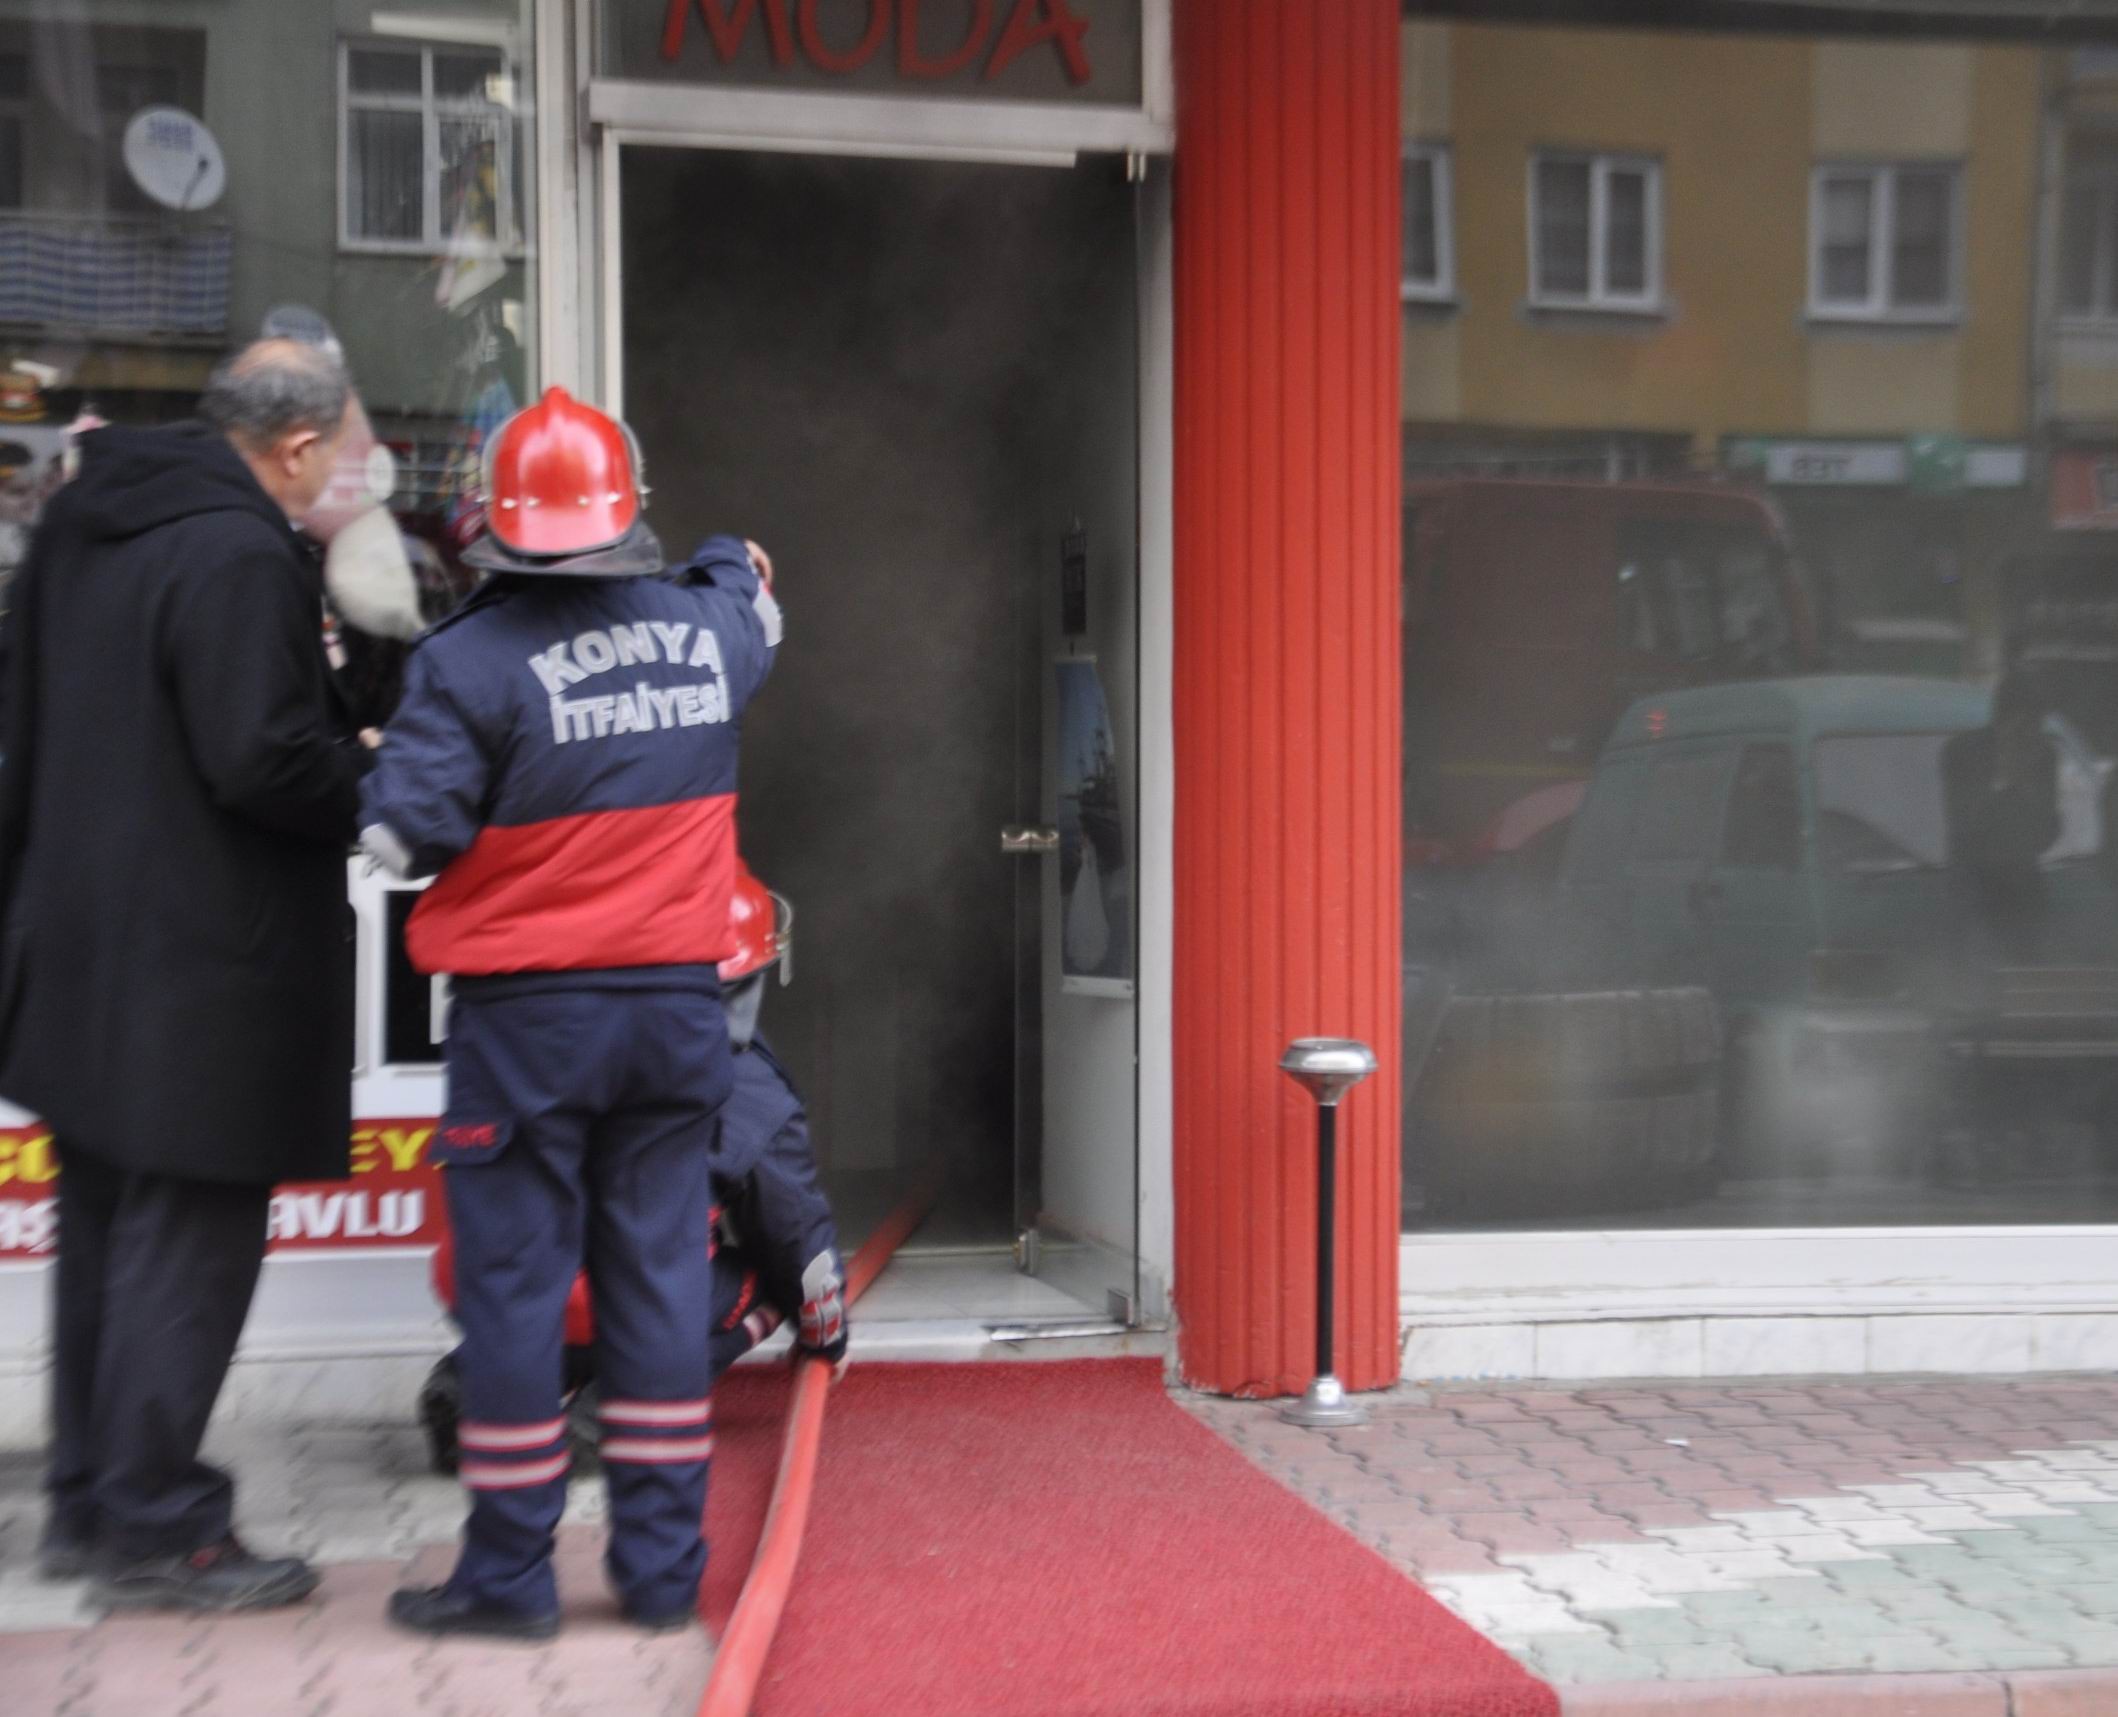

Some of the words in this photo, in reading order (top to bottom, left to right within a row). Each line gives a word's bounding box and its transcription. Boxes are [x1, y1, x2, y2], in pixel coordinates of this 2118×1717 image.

[662, 0, 1091, 85] MODA
[527, 620, 724, 697] KONYA
[548, 672, 732, 745] İTFAİYESİ
[350, 1127, 447, 1173] EY
